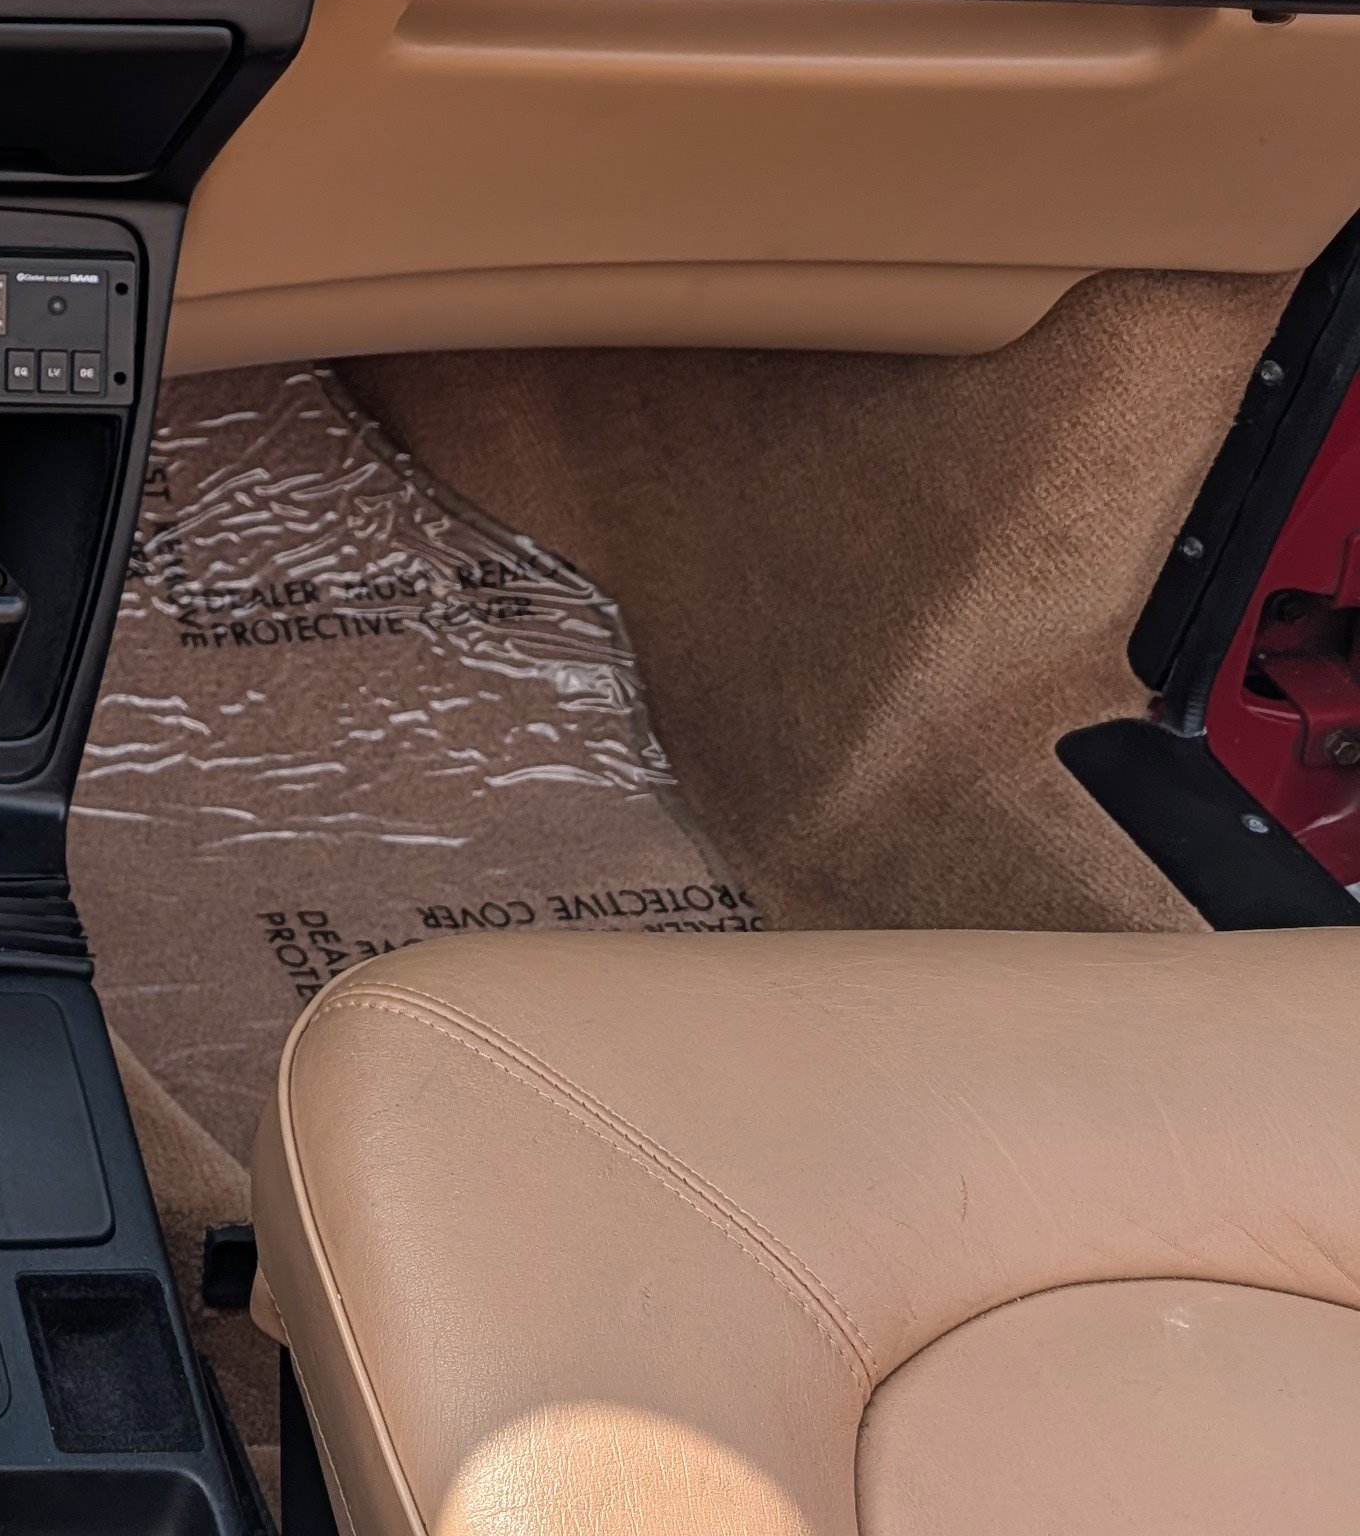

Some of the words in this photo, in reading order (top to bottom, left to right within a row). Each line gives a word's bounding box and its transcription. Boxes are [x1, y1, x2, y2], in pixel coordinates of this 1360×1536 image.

[48, 368, 61, 377] LV
[212, 615, 406, 648] PROTECTIVE
[420, 901, 535, 930] COVER
[296, 910, 350, 966] DEA
